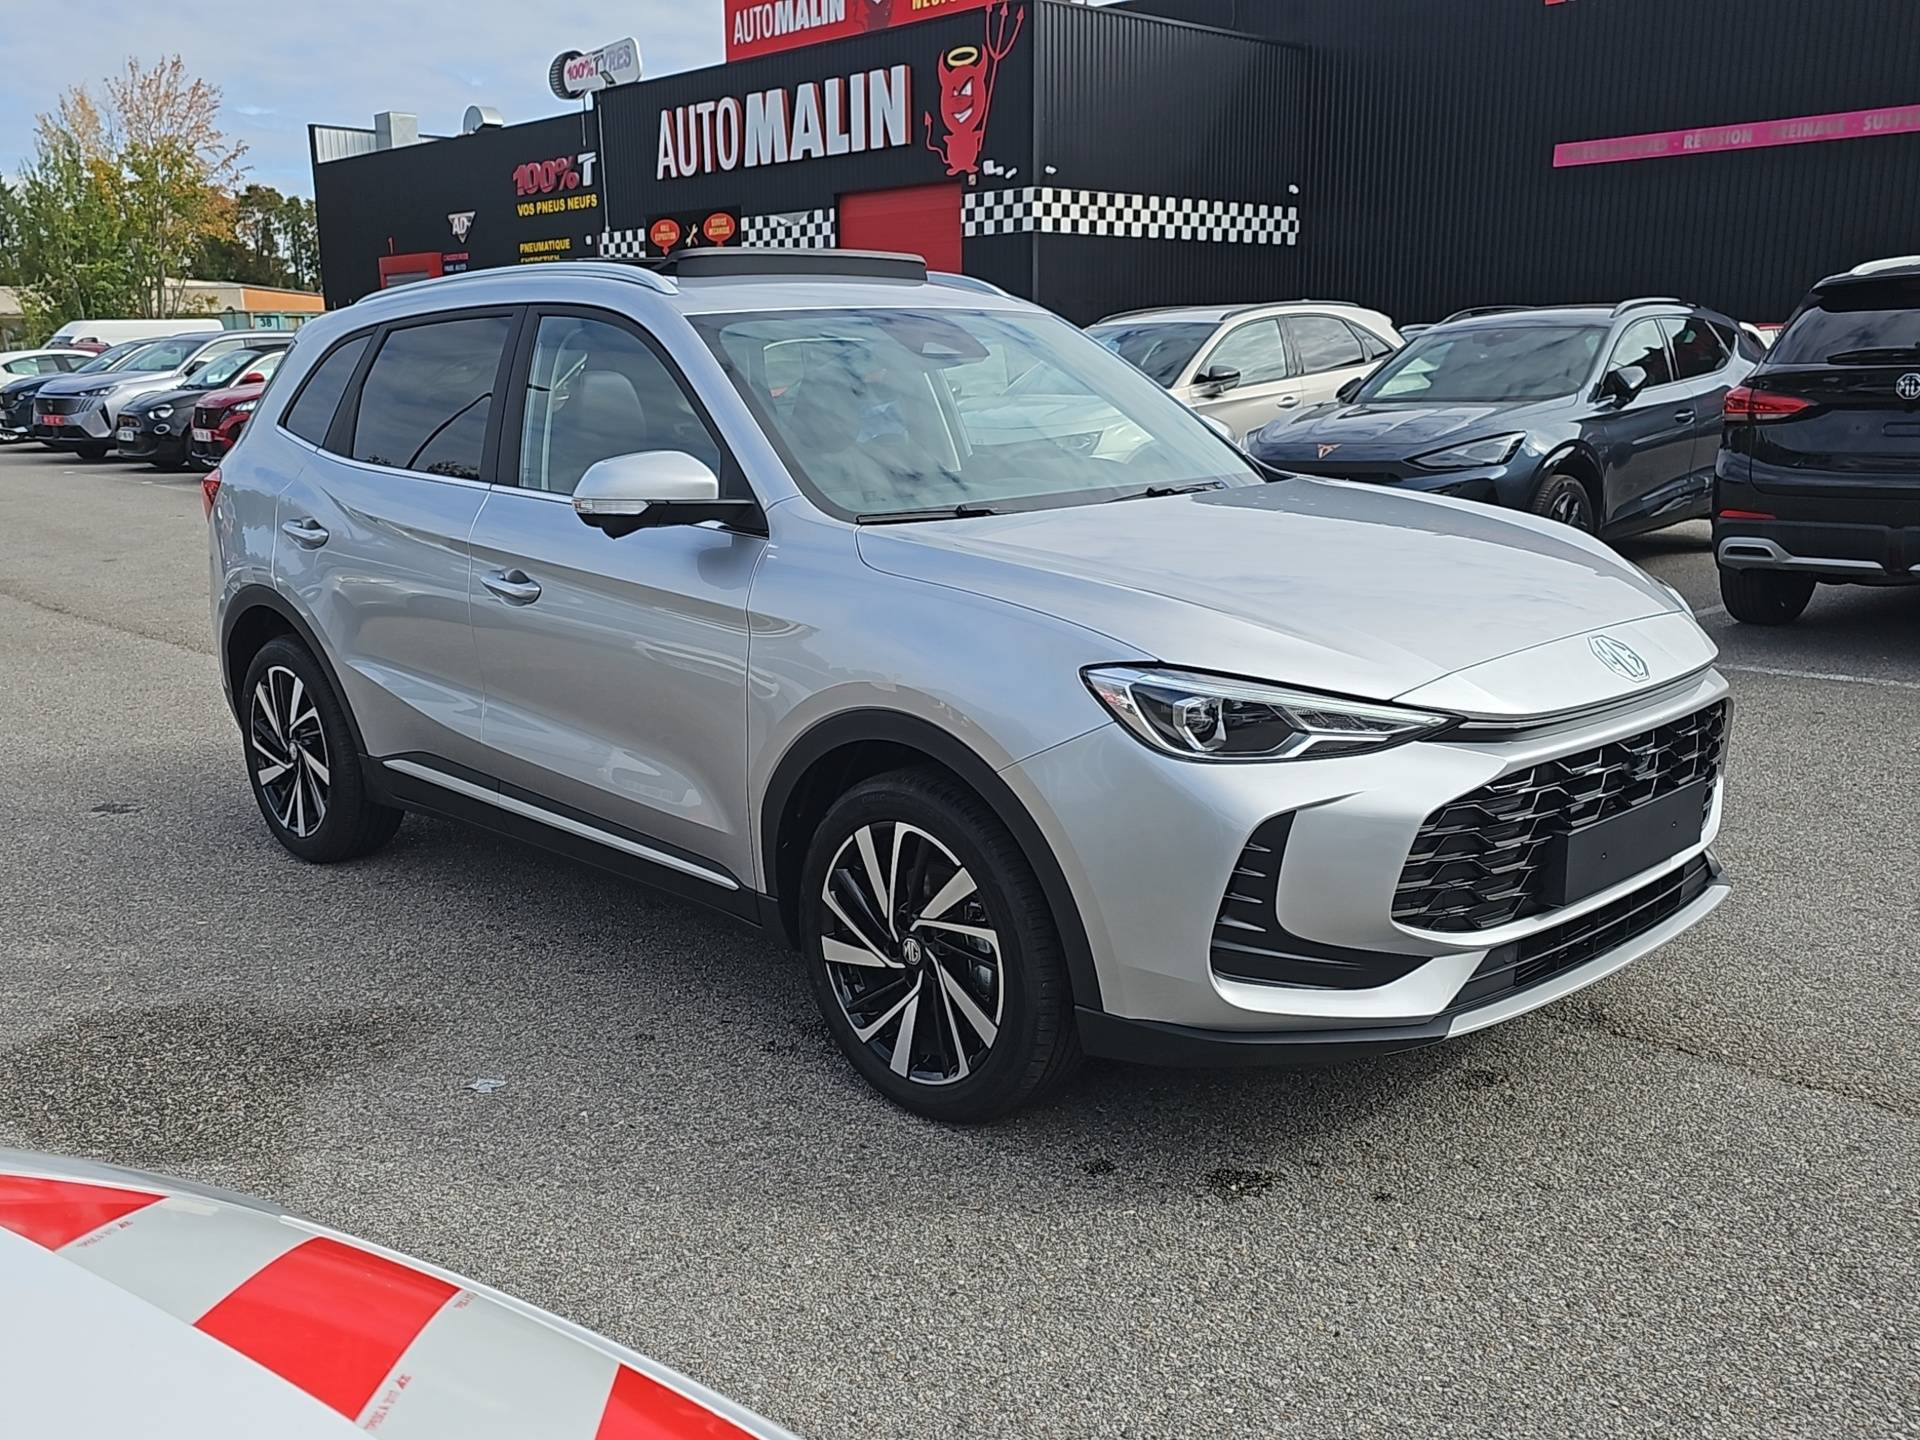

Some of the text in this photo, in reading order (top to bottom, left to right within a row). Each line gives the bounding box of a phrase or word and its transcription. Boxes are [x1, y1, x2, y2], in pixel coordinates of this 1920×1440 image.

[656, 64, 911, 181] AUTOMALIN
[517, 194, 598, 217] VOS PNEUS NEUFS
[519, 238, 571, 254] PNEUMATIQUE
